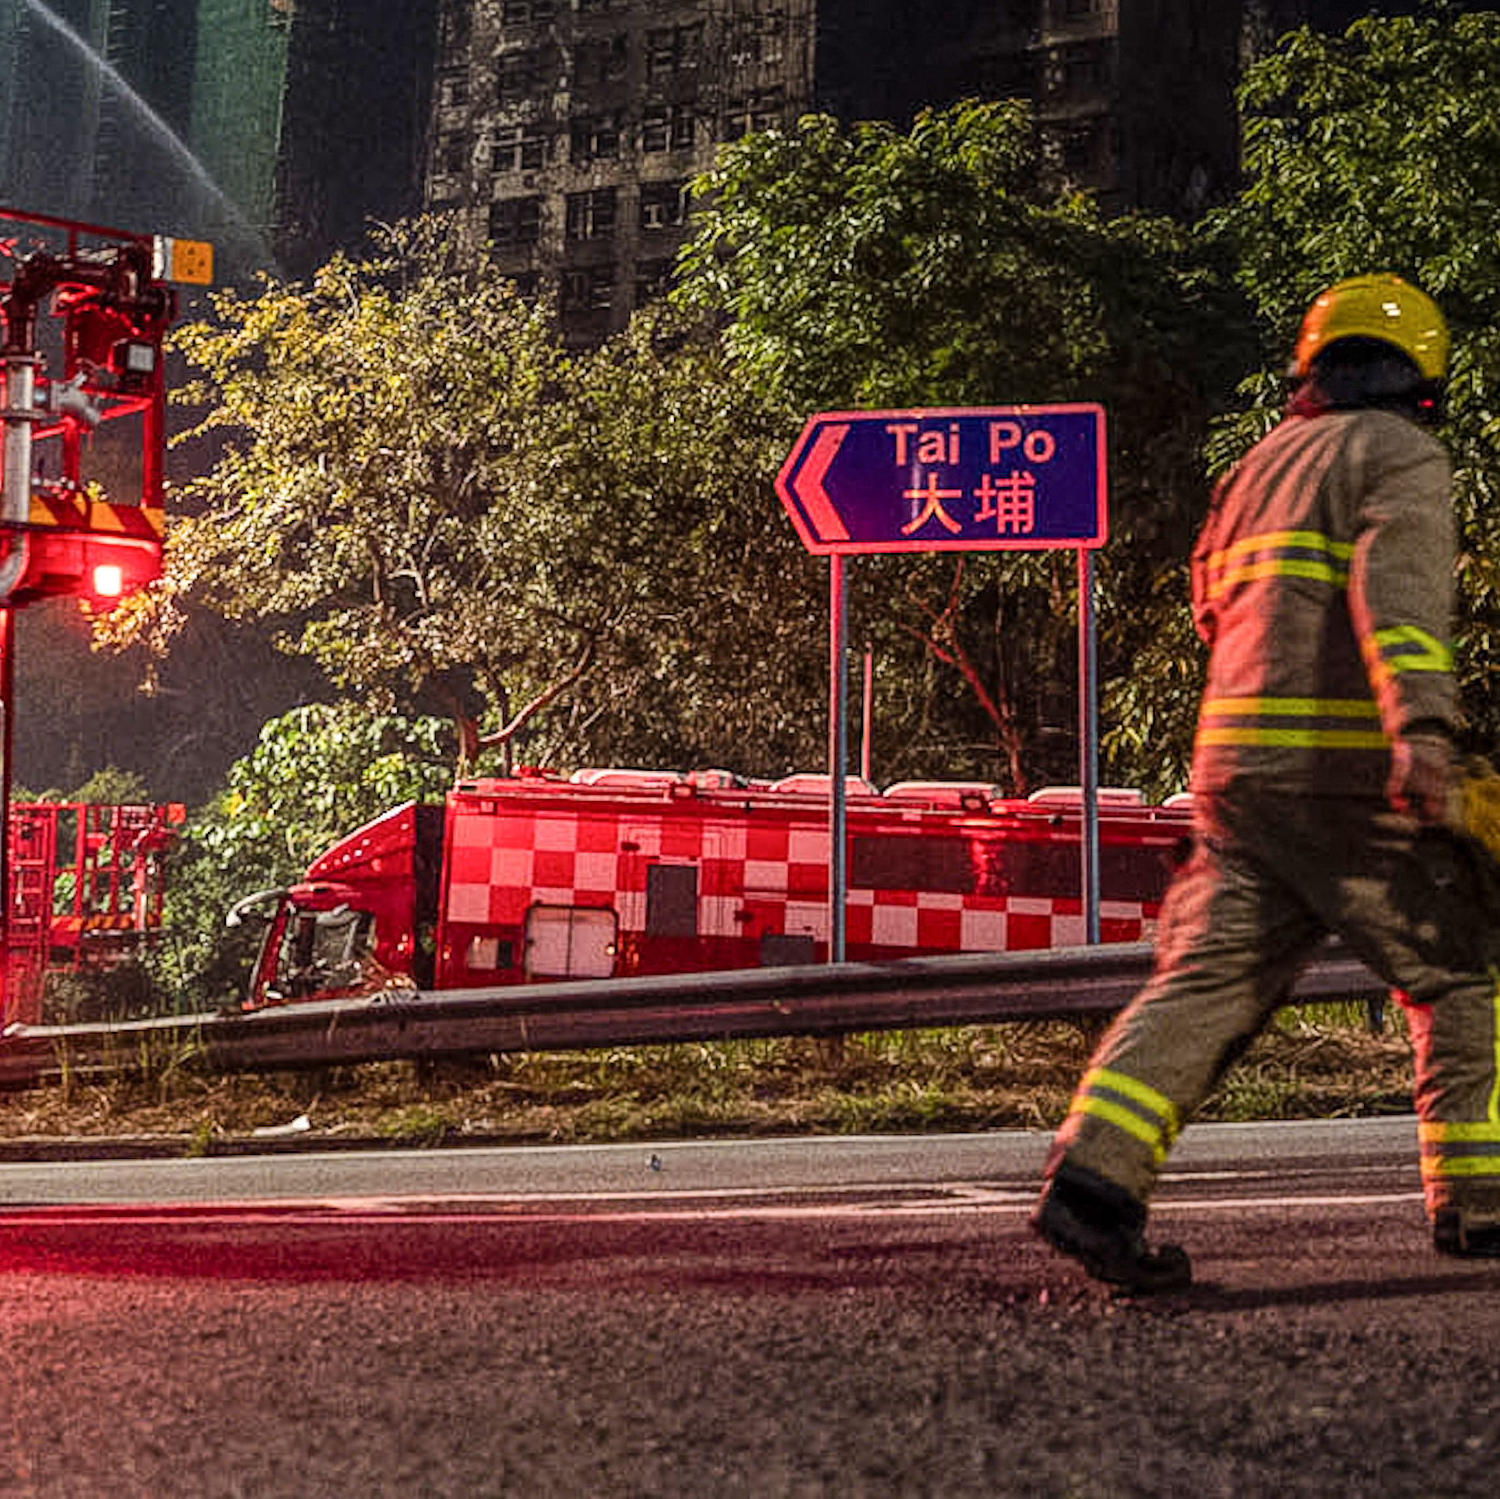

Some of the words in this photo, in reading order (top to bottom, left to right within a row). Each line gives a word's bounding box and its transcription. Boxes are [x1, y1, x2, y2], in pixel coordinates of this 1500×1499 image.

[886, 424, 960, 465] Tai
[989, 421, 1056, 464] Po
[901, 470, 1037, 536] 大埔
